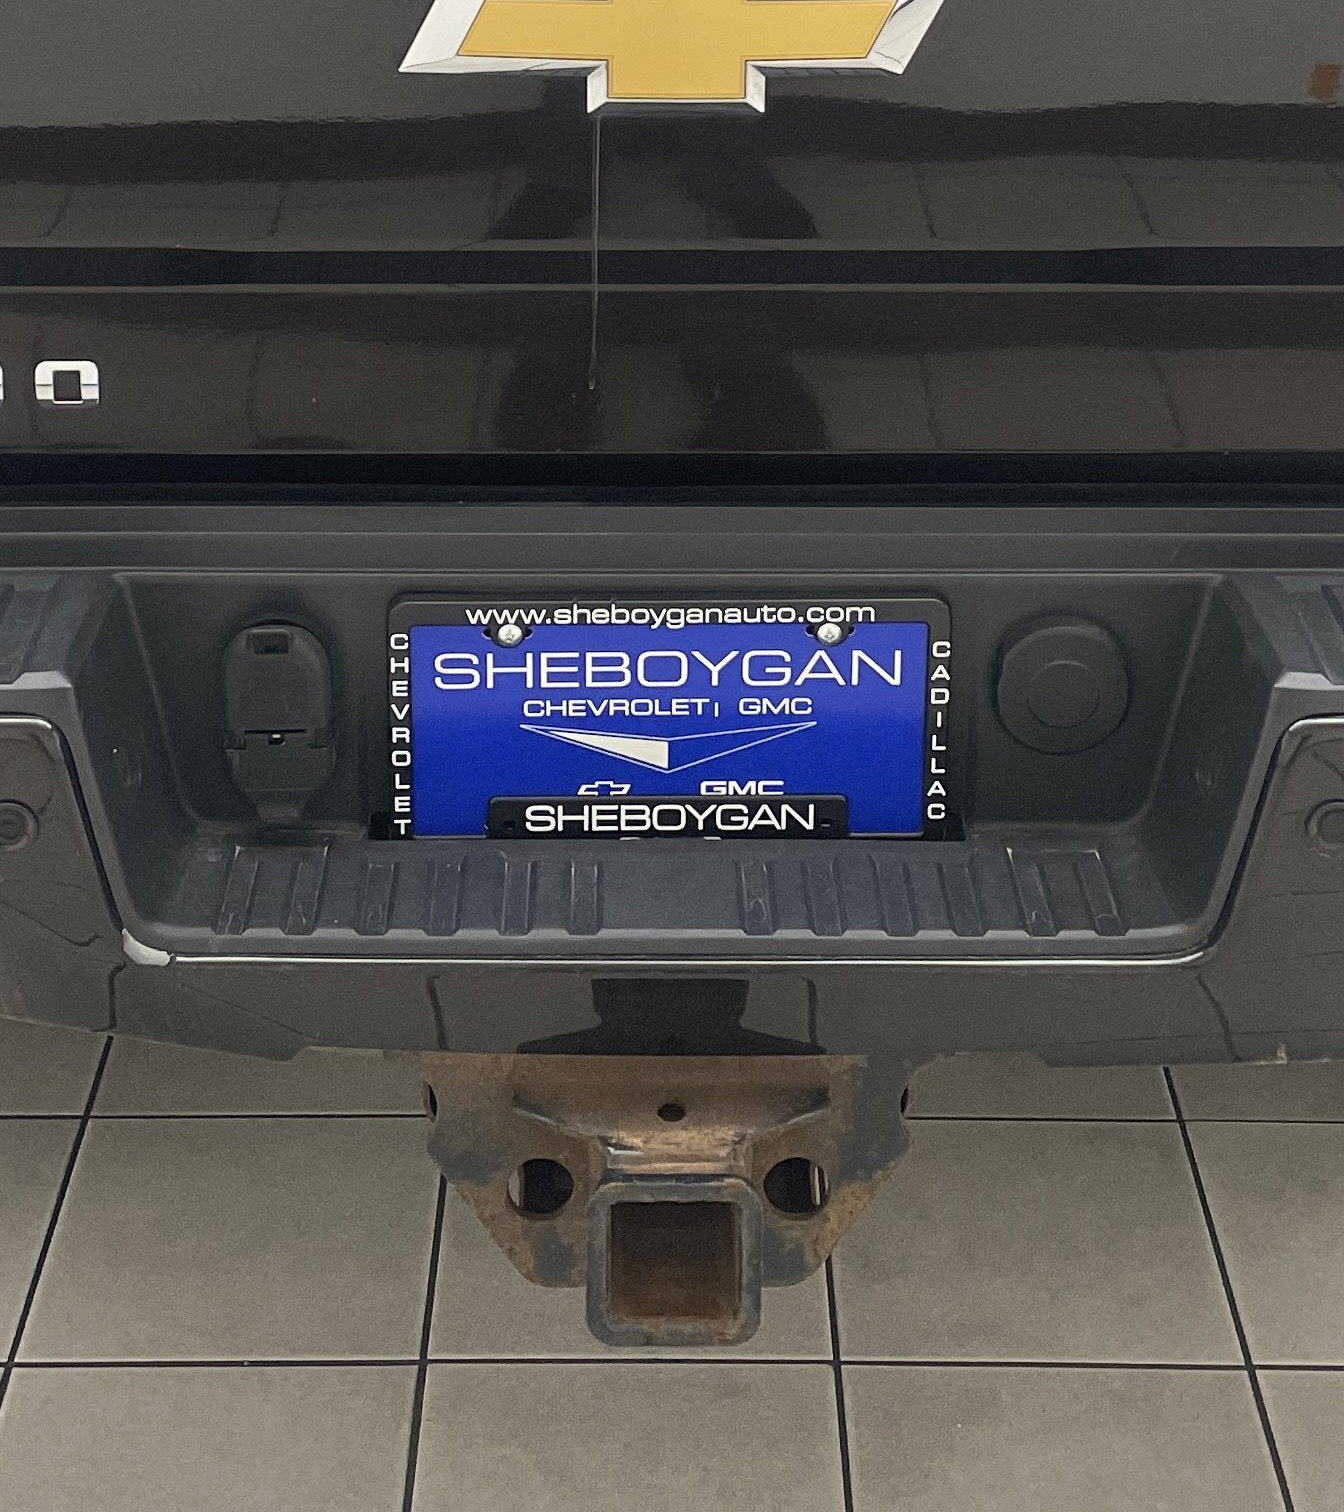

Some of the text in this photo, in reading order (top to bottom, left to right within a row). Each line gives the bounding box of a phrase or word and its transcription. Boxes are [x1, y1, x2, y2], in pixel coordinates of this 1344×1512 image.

[465, 603, 877, 630] www.sheboyganauto.com
[432, 648, 903, 691] SHEBOYGAN
[522, 697, 814, 718] CHEVROLET GMC
[389, 632, 413, 837] CHEVROLET
[926, 640, 952, 821] CADILLAC
[699, 779, 785, 796] GMC
[524, 802, 816, 834] SHEBOYGAN
